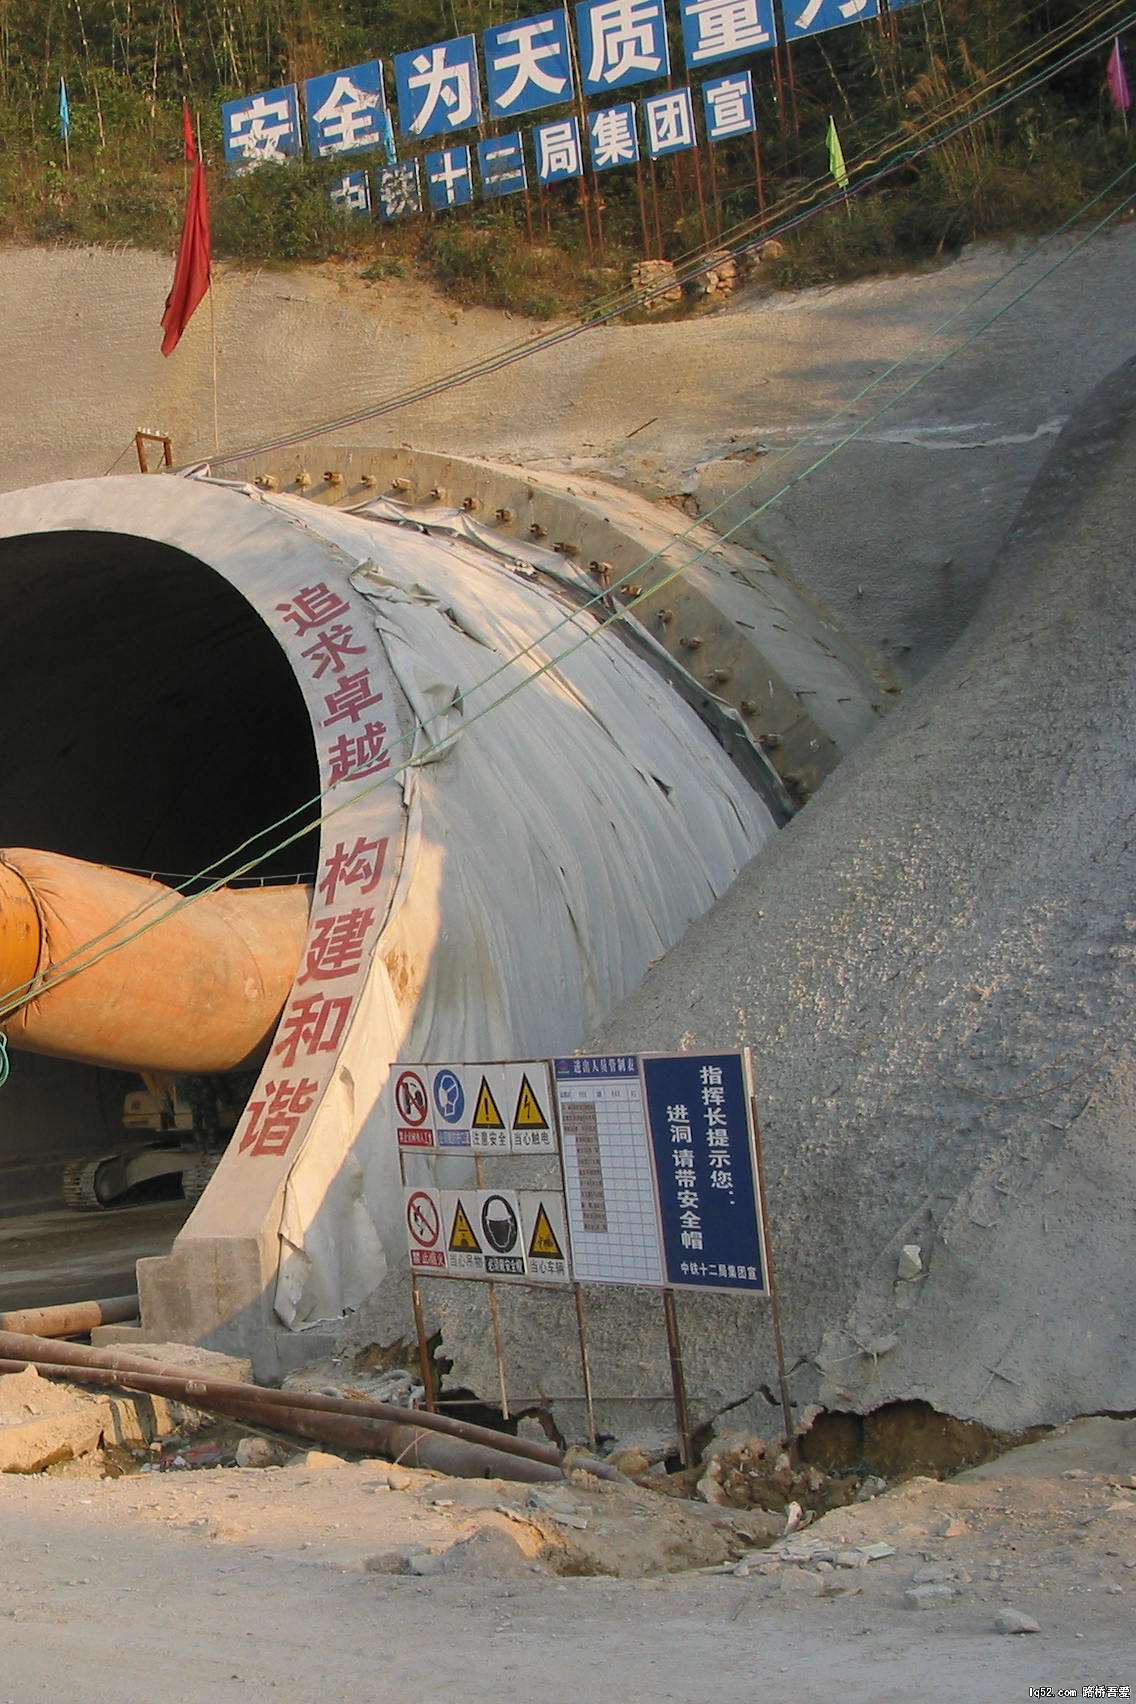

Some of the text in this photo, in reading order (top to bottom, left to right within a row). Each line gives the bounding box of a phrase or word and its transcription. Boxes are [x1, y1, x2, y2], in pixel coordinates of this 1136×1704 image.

[238, 580, 391, 1157] 追求卓越 构建和谐
[472, 1132, 507, 1146] 注意安全
[514, 1132, 550, 1146] 当心触电
[530, 1260, 565, 1276] 当心车辆
[680, 1262, 757, 1281] 中铁十二局集团宣
